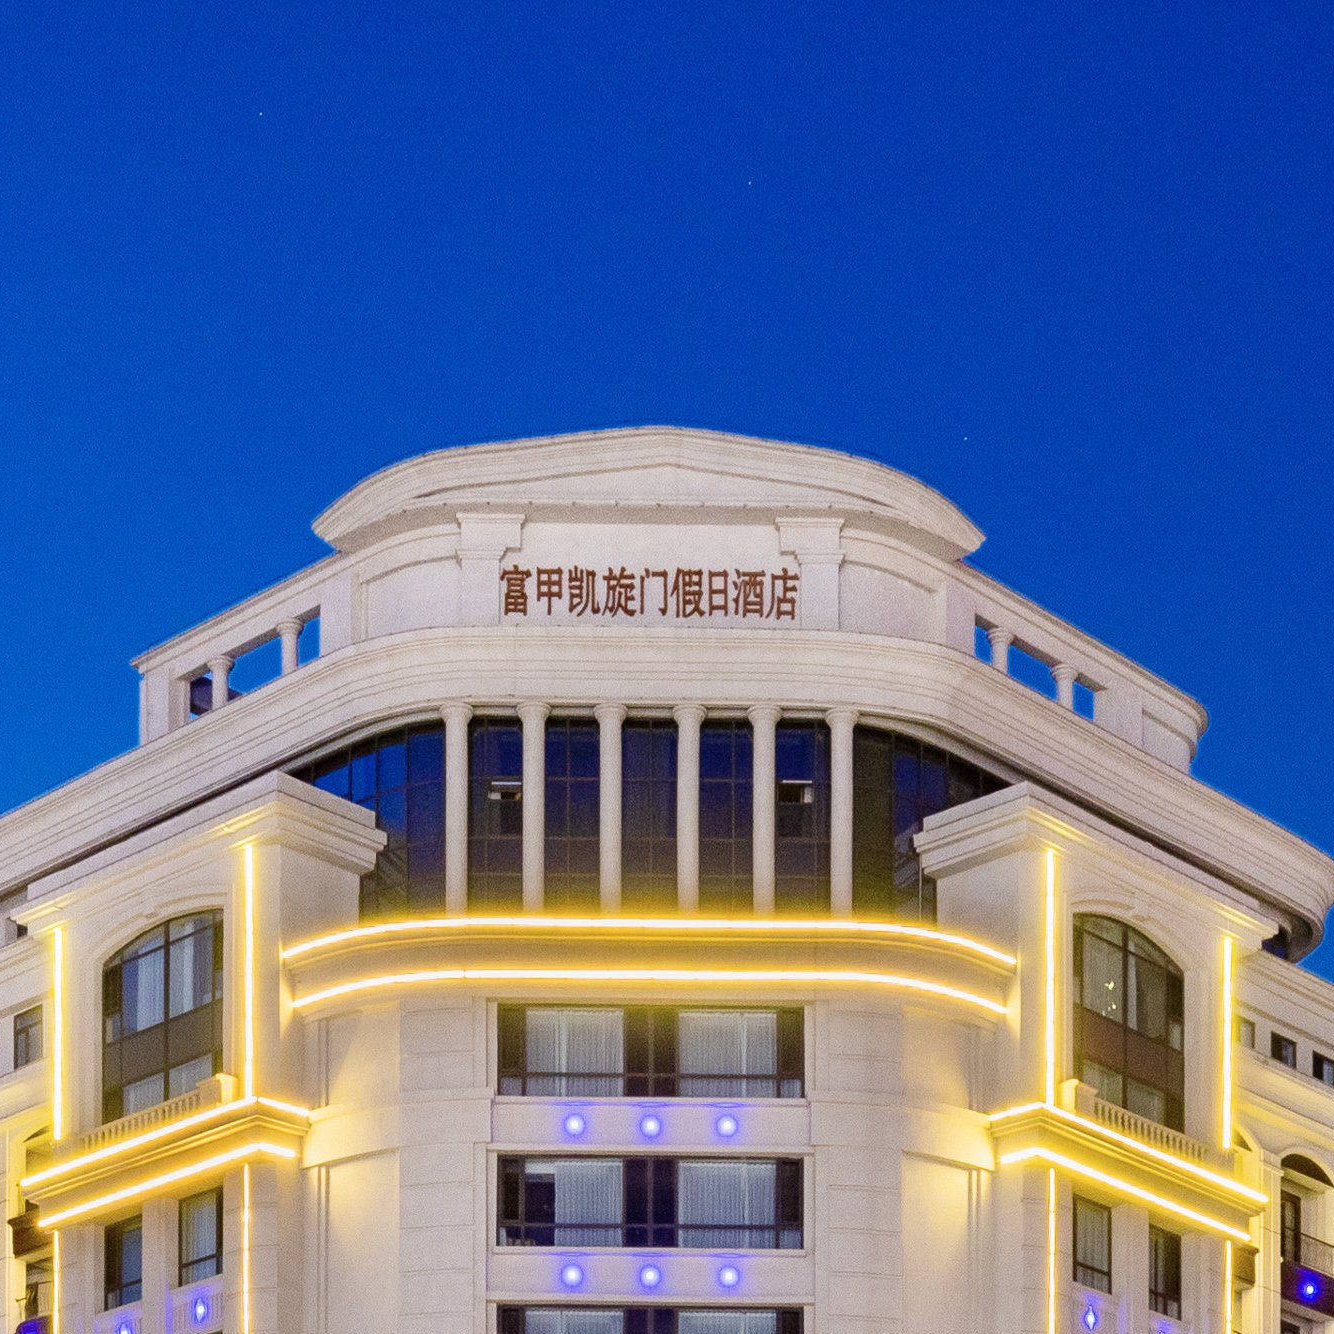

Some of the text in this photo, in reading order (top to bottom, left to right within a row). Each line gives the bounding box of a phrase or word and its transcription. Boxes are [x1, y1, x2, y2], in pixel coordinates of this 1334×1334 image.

[500, 565, 800, 620] 富甲凯旋门假日酒店
